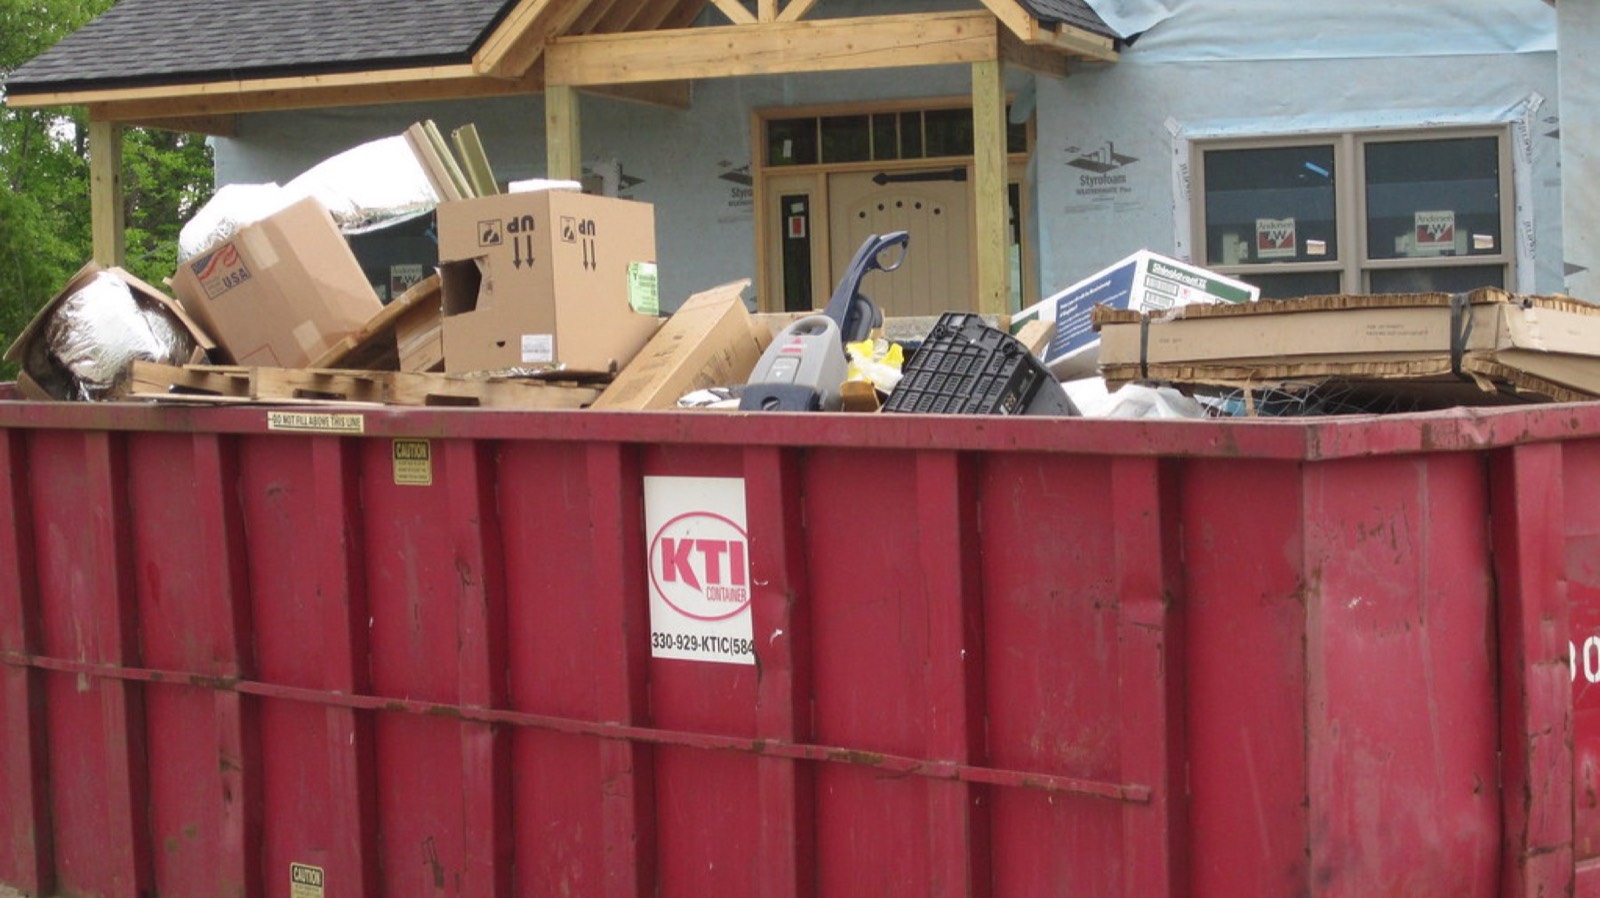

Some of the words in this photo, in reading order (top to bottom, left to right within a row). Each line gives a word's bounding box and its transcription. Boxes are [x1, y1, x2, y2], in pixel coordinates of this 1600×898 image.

[1080, 174, 1128, 187] Styrofoam
[507, 215, 534, 233] UP
[578, 219, 595, 236] UP
[222, 267, 249, 289] USA
[282, 413, 295, 426] NOT
[309, 415, 330, 427] ABOVE
[331, 415, 345, 428] THIS
[396, 442, 427, 458] CAUTION
[661, 537, 746, 592] KTI
[706, 585, 747, 603] CONTAINER
[294, 866, 321, 885] CAUTION
